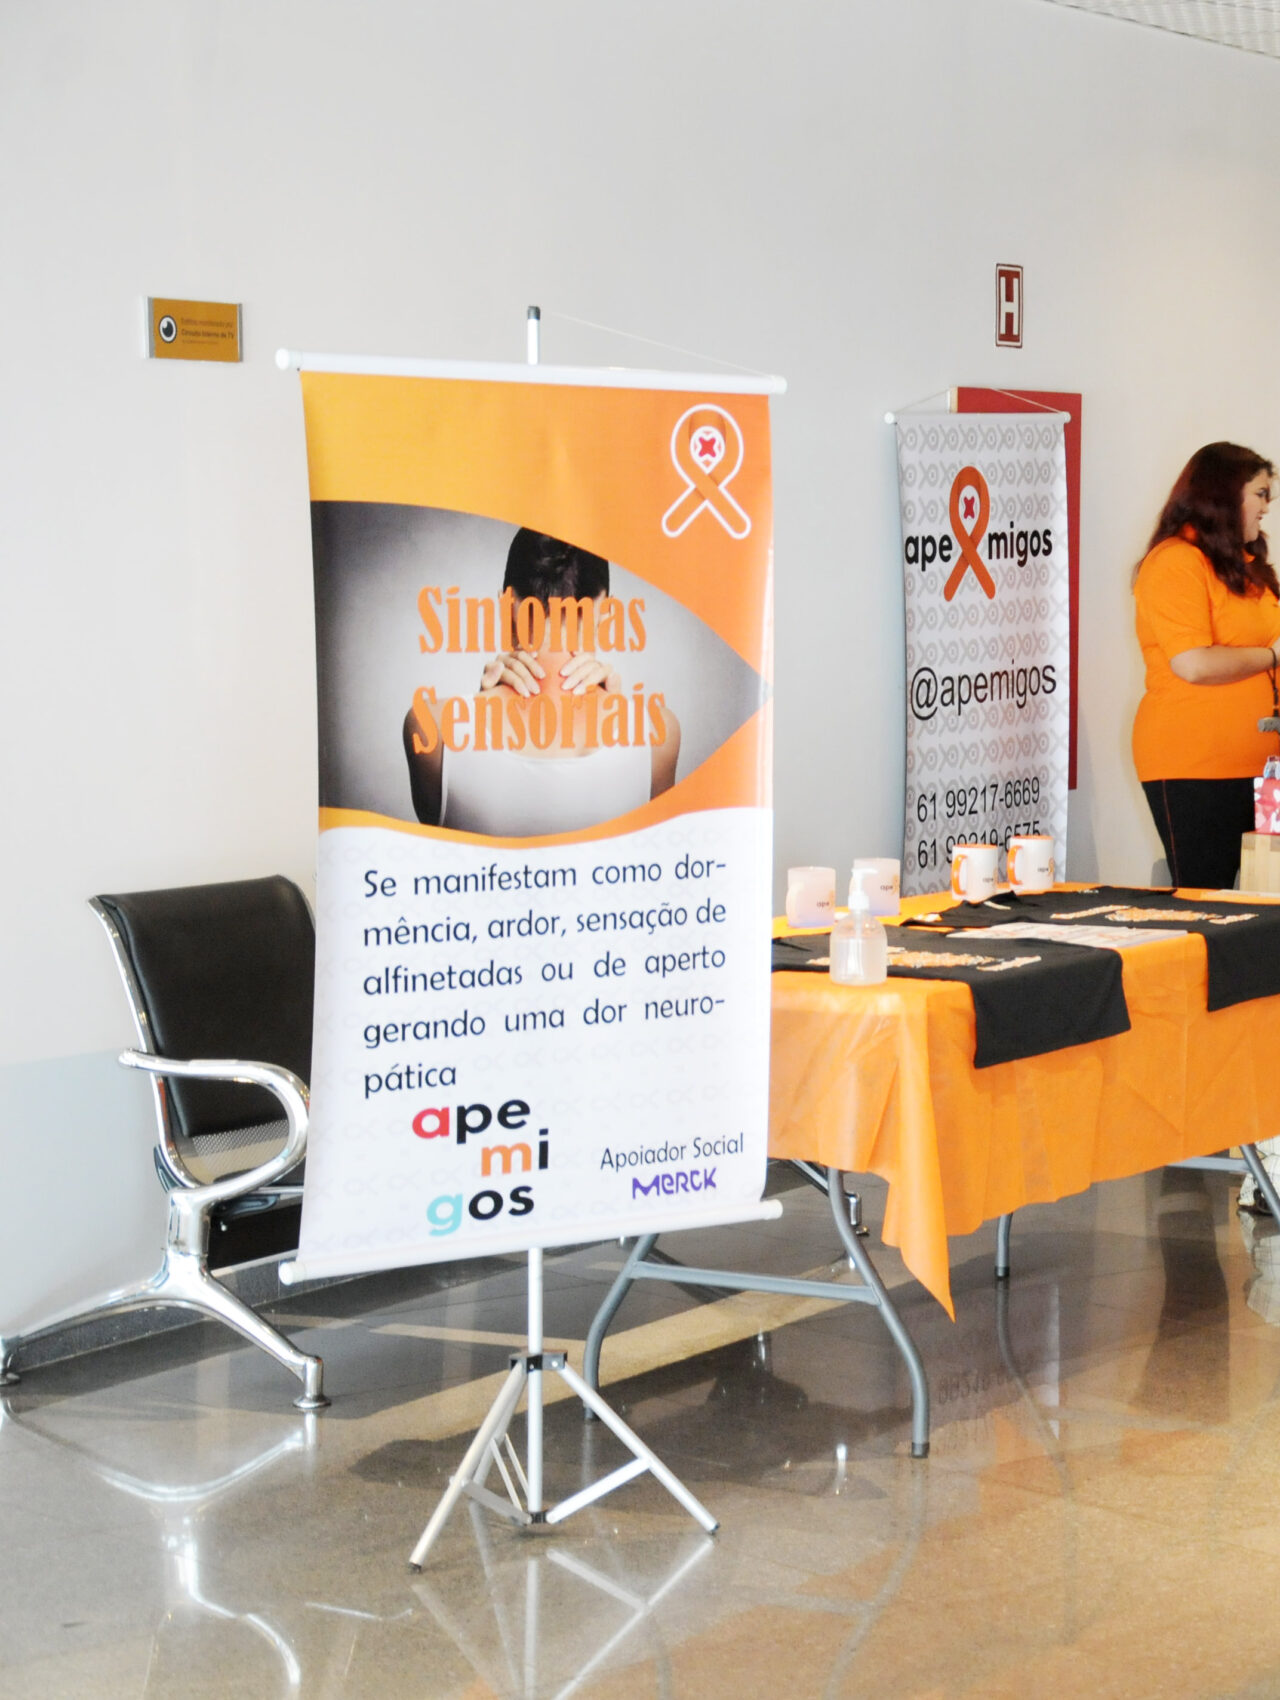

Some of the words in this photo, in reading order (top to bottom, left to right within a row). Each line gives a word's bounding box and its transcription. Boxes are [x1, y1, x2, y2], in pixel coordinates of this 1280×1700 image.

[999, 276, 1019, 336] H
[416, 584, 647, 655] Sintomas
[910, 659, 1057, 721] @apemigos
[411, 681, 667, 755] Sensoriais
[917, 792, 937, 823] 61
[945, 777, 1040, 818] 99217-6669
[363, 869, 397, 898] Se
[413, 863, 577, 895] manifestam
[591, 861, 663, 885] como
[674, 853, 727, 880] dor-
[917, 838, 937, 869] 61
[363, 916, 478, 947] mência,
[487, 910, 567, 938] ardor,
[576, 902, 688, 934] sensação
[695, 897, 727, 924] de
[363, 960, 523, 996] alfinetadas
[540, 961, 574, 982] ou
[593, 951, 627, 978] de
[644, 945, 726, 979] aperto
[363, 1009, 486, 1049] gerando
[504, 1008, 565, 1033] uma
[582, 998, 628, 1026] dor
[644, 995, 726, 1021] neuro-
[363, 1063, 457, 1099] pática
[412, 1099, 531, 1145] ape
[480, 1128, 549, 1177] mi
[599, 1139, 687, 1173] Apoiador
[692, 1132, 744, 1159] Social
[426, 1185, 535, 1237] gos
